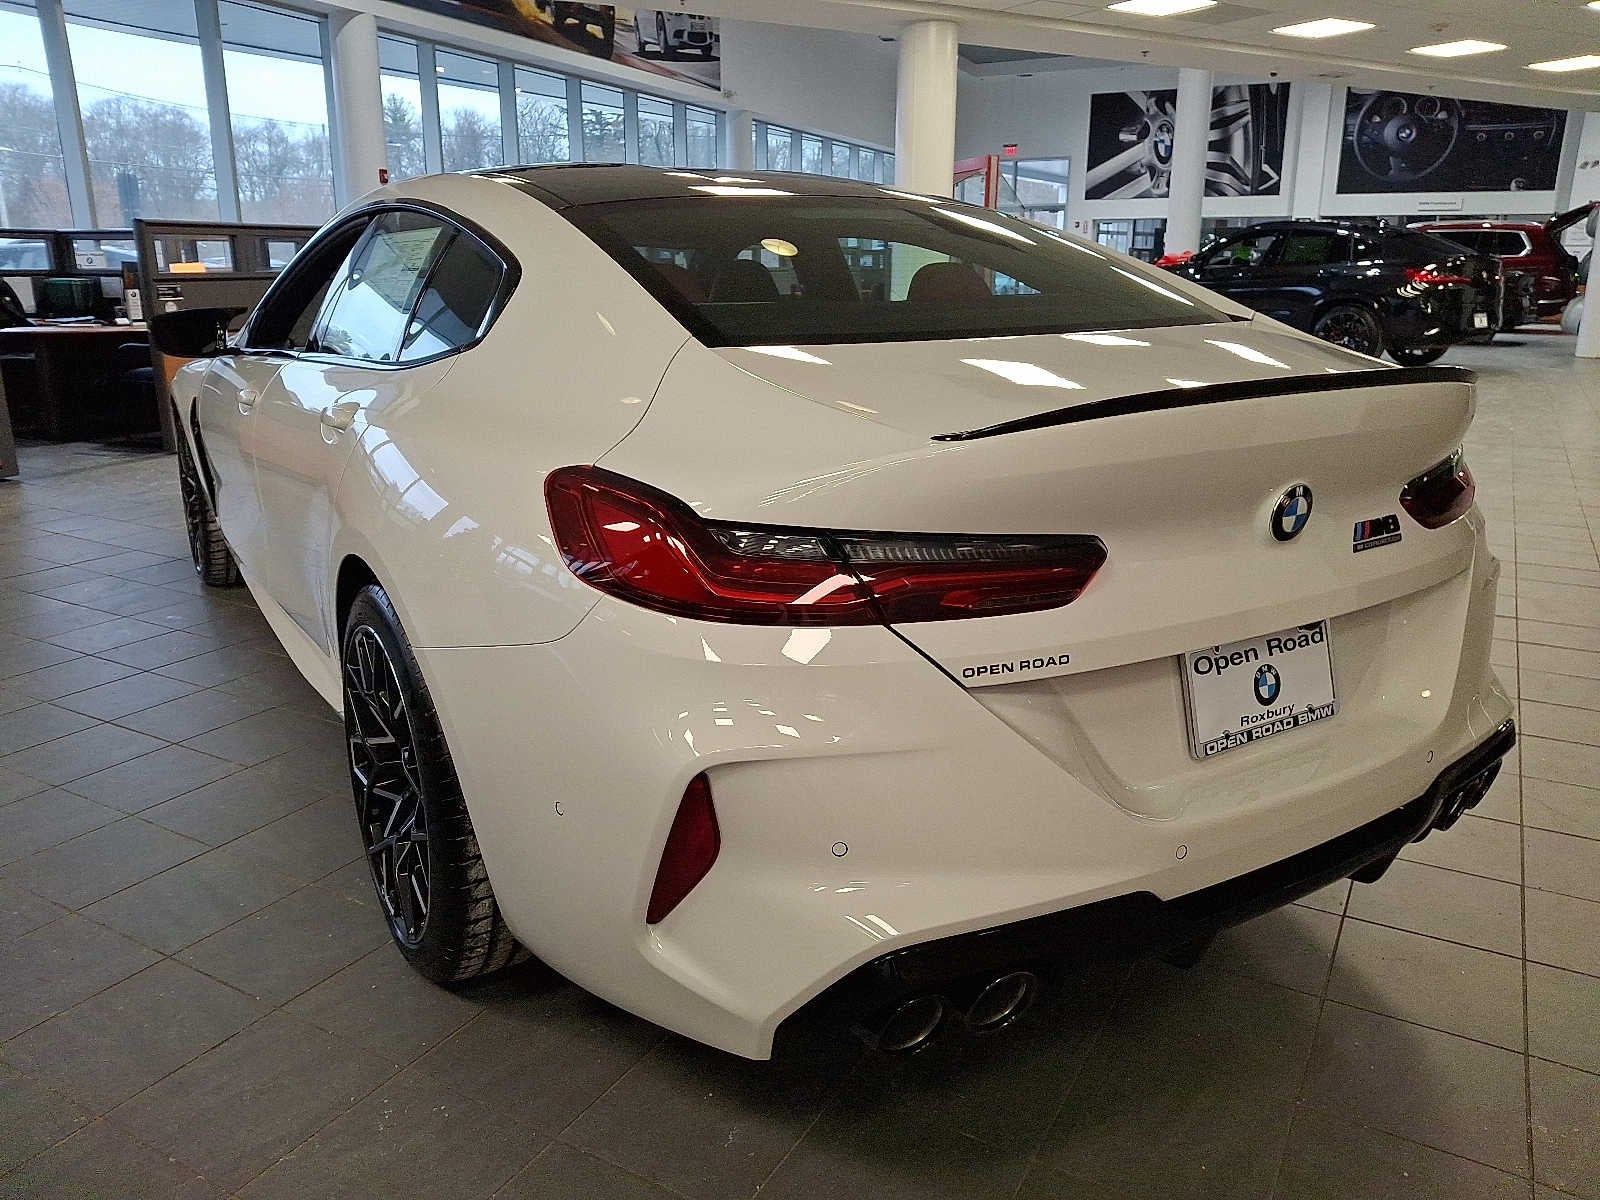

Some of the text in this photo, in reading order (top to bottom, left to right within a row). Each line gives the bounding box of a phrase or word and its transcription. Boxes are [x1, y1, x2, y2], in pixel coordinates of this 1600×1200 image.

[962, 654, 1070, 679] OPEN ROAD
[1194, 626, 1325, 675] Open Road
[1205, 704, 1334, 756] OPEN ROAD BMW
[1240, 703, 1296, 727] Roxbury
